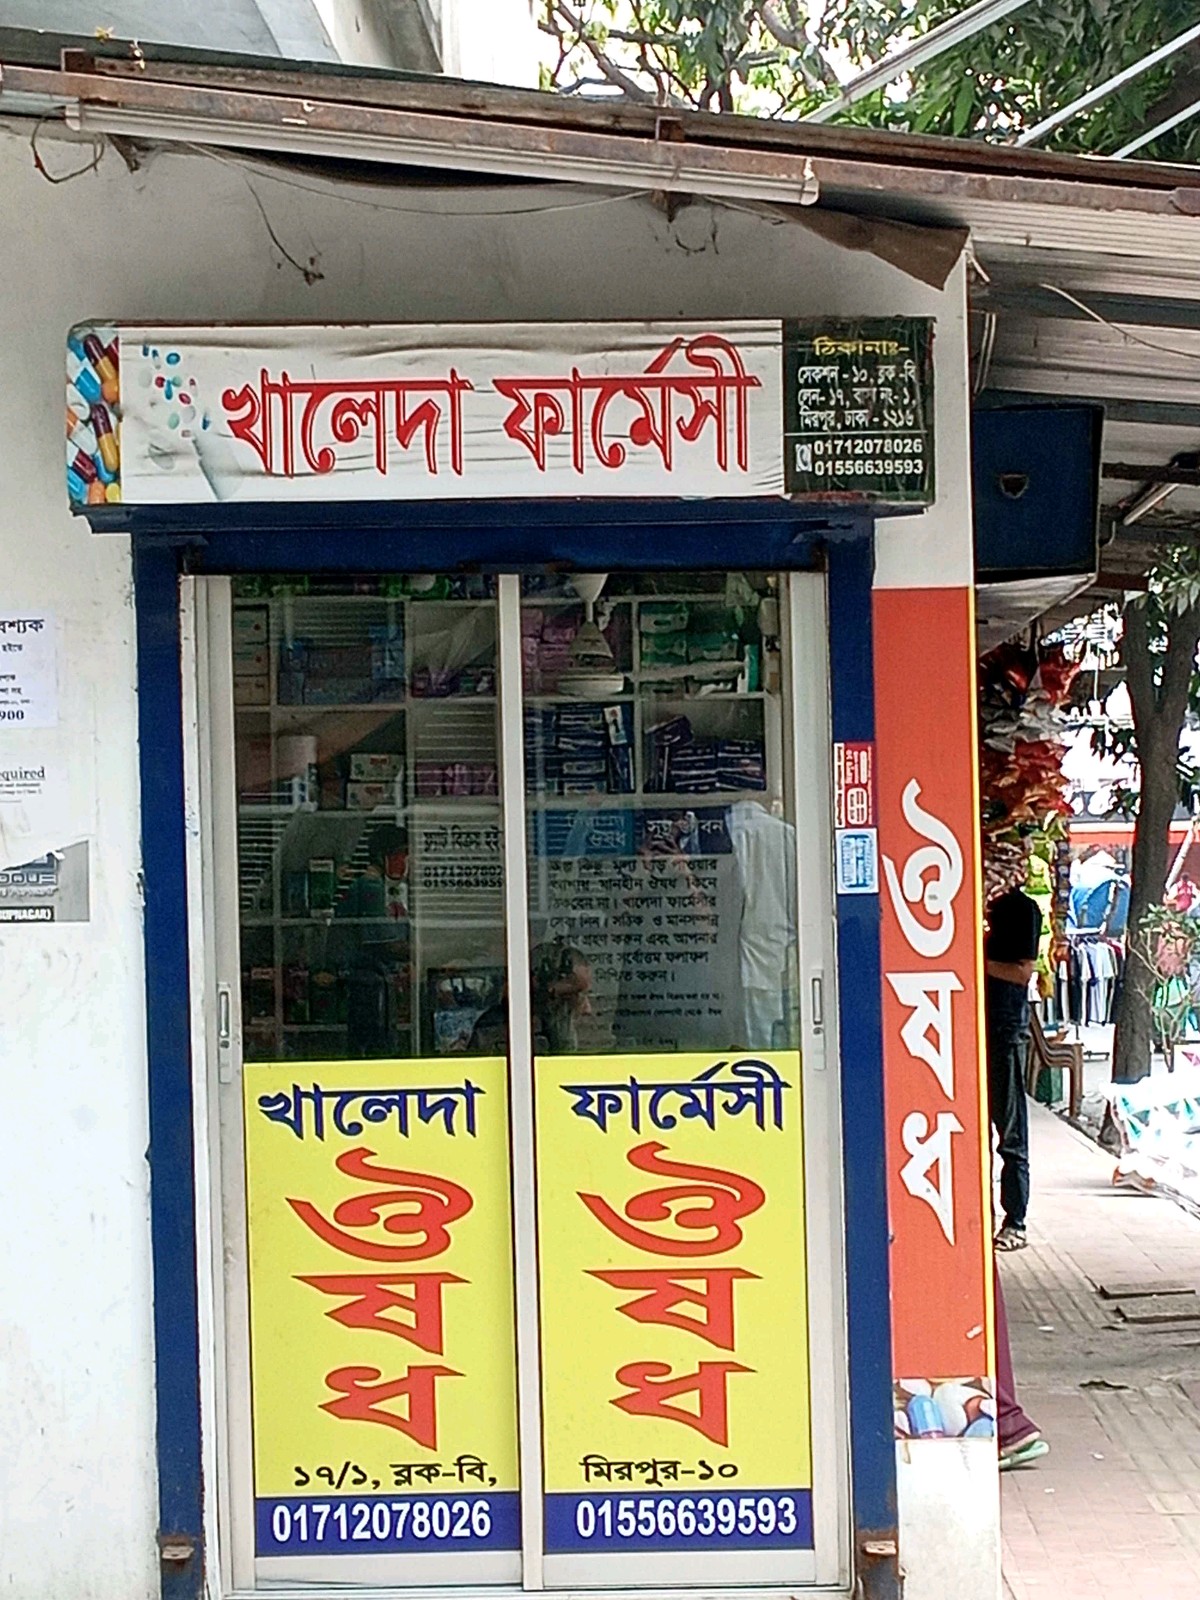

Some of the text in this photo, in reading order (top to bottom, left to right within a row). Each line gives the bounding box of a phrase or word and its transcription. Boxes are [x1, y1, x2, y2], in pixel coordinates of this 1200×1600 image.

[798, 365, 839, 384] সেকশন
[221, 333, 762, 477] খালেদা ফার্মেসী
[844, 410, 870, 428] ঢাকা
[814, 438, 923, 456] 01712078026
[814, 460, 924, 476] 01556639593
[0, 765, 45, 782] quired
[259, 1059, 793, 1141] খালেদা ফার্মেসী
[293, 1455, 498, 1491] ১৭/১, ব্লক-বি,
[578, 1454, 740, 1487] মিরপুর-১০
[272, 1499, 492, 1543] 01712078026
[576, 1496, 797, 1538] 01556639593
